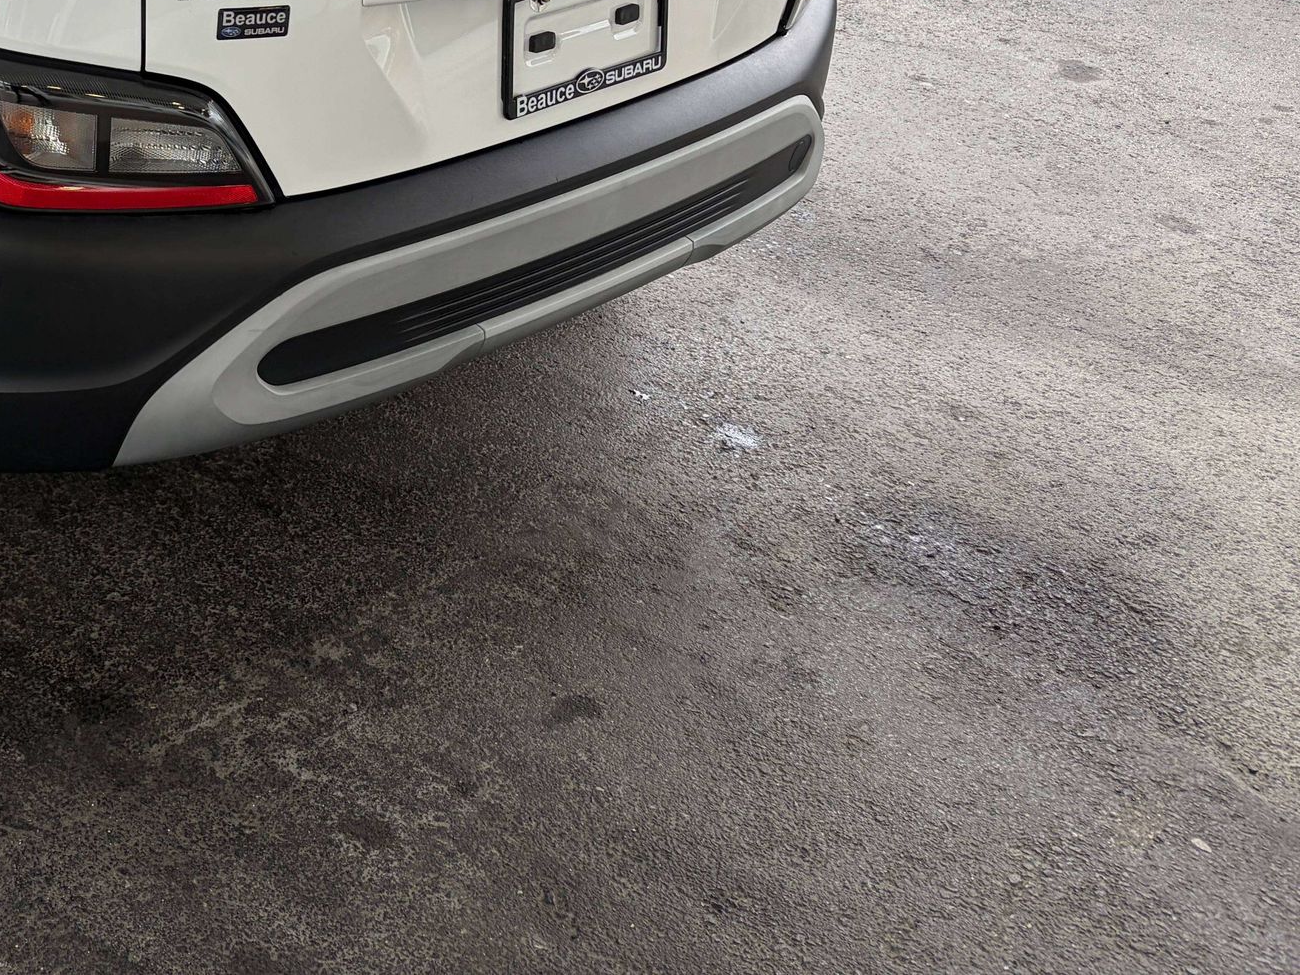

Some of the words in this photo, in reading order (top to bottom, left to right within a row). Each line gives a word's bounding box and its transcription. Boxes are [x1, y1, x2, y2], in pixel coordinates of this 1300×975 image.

[222, 10, 286, 26] Beauce
[244, 27, 285, 36] SUBARU
[516, 83, 575, 118] Beauce
[605, 56, 662, 85] SUBARU
